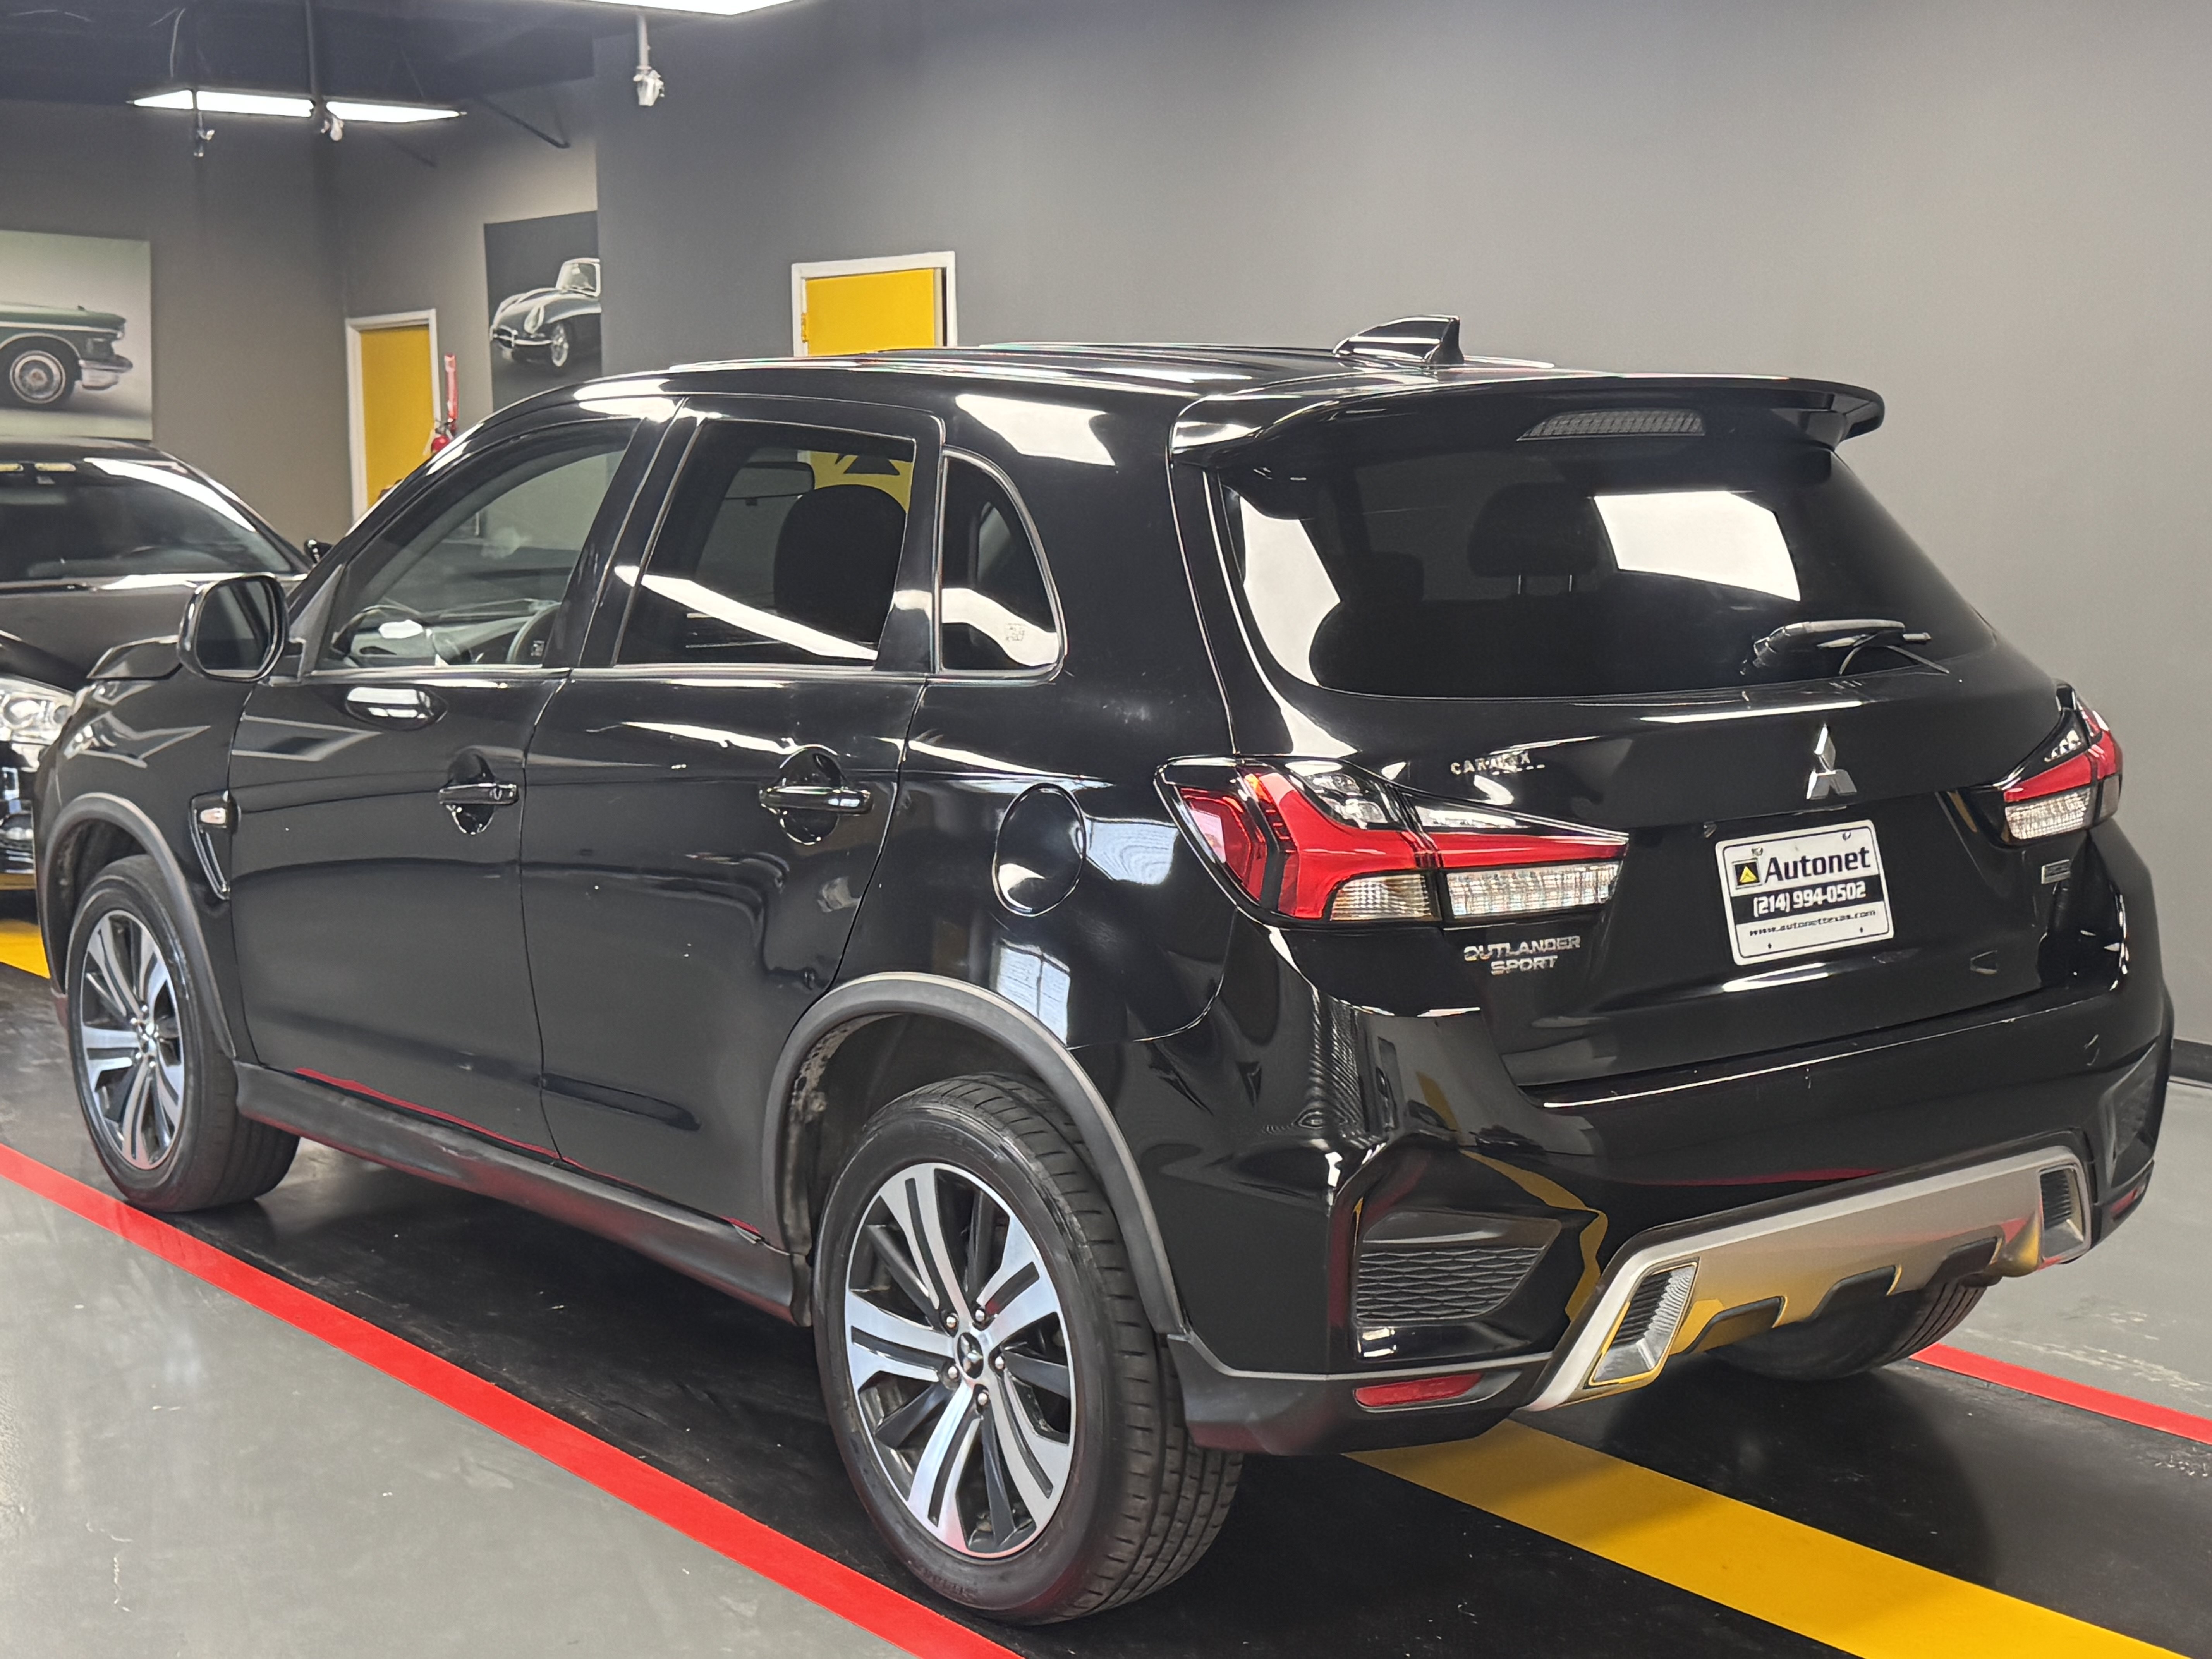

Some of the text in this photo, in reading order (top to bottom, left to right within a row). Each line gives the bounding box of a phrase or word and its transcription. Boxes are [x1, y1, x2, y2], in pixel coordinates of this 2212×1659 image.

[1765, 847, 1870, 883] Autonet
[1753, 881, 1866, 917] (214) 994-0502
[1464, 936, 1581, 961] OUTLANDER
[1491, 955, 1558, 975] SPORT
